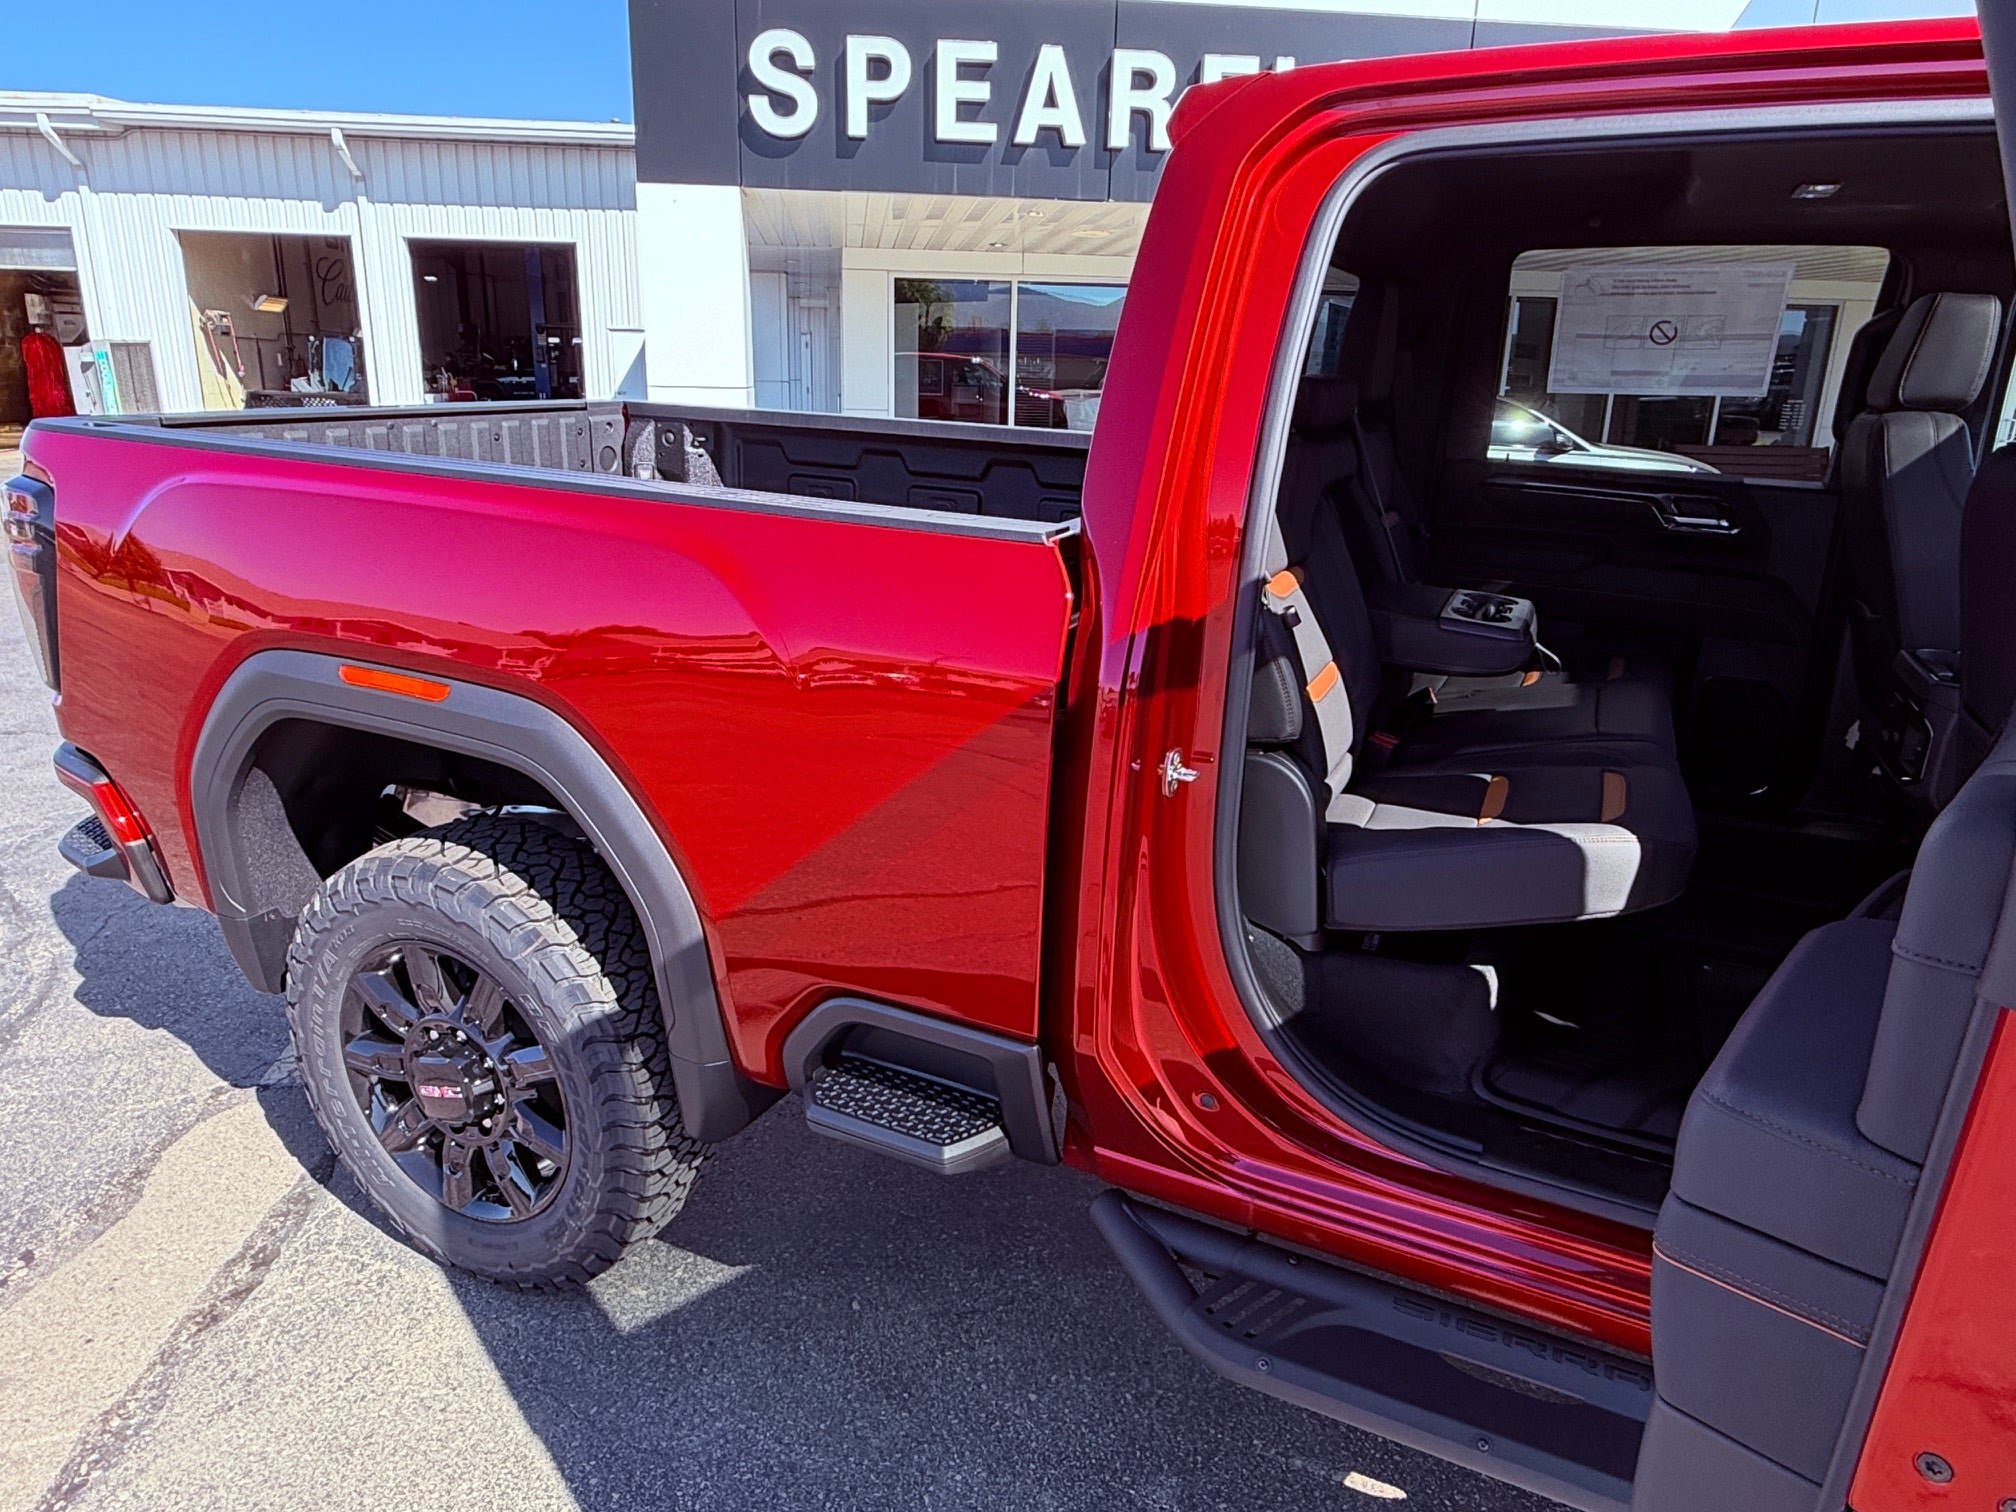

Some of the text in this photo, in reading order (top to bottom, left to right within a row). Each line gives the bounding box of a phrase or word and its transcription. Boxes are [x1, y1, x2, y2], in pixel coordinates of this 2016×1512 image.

[748, 28, 1296, 152] SPEAR
[418, 1085, 463, 1099] GMC
[1393, 1296, 1652, 1392] SIERRA
